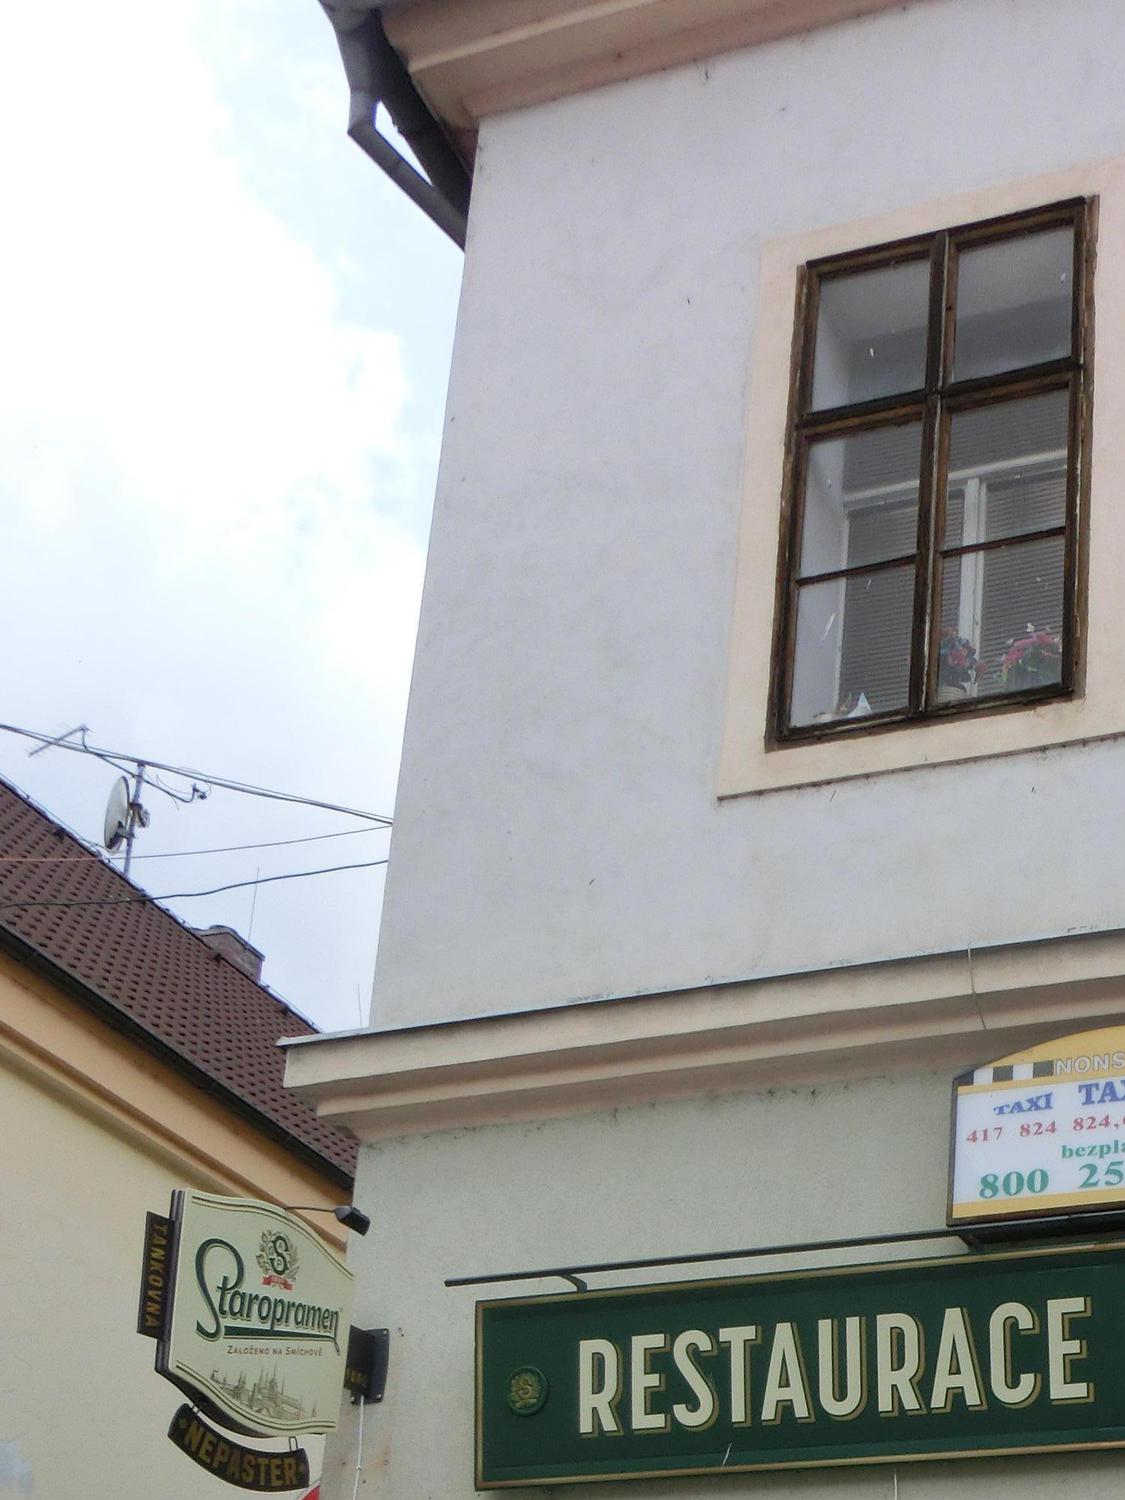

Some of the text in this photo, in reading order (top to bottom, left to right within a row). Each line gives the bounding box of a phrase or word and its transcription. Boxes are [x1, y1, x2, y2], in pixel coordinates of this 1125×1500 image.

[966, 1126, 1004, 1144] 417
[1019, 1121, 1058, 1138] 824
[993, 1092, 1054, 1116] TAXI
[979, 1168, 1050, 1200] 800
[145, 1224, 168, 1328] TANKOVNA
[195, 1237, 341, 1357] Staropramen
[579, 1296, 1094, 1437] RESTAURACE
[184, 1420, 298, 1487] NEPASTER
